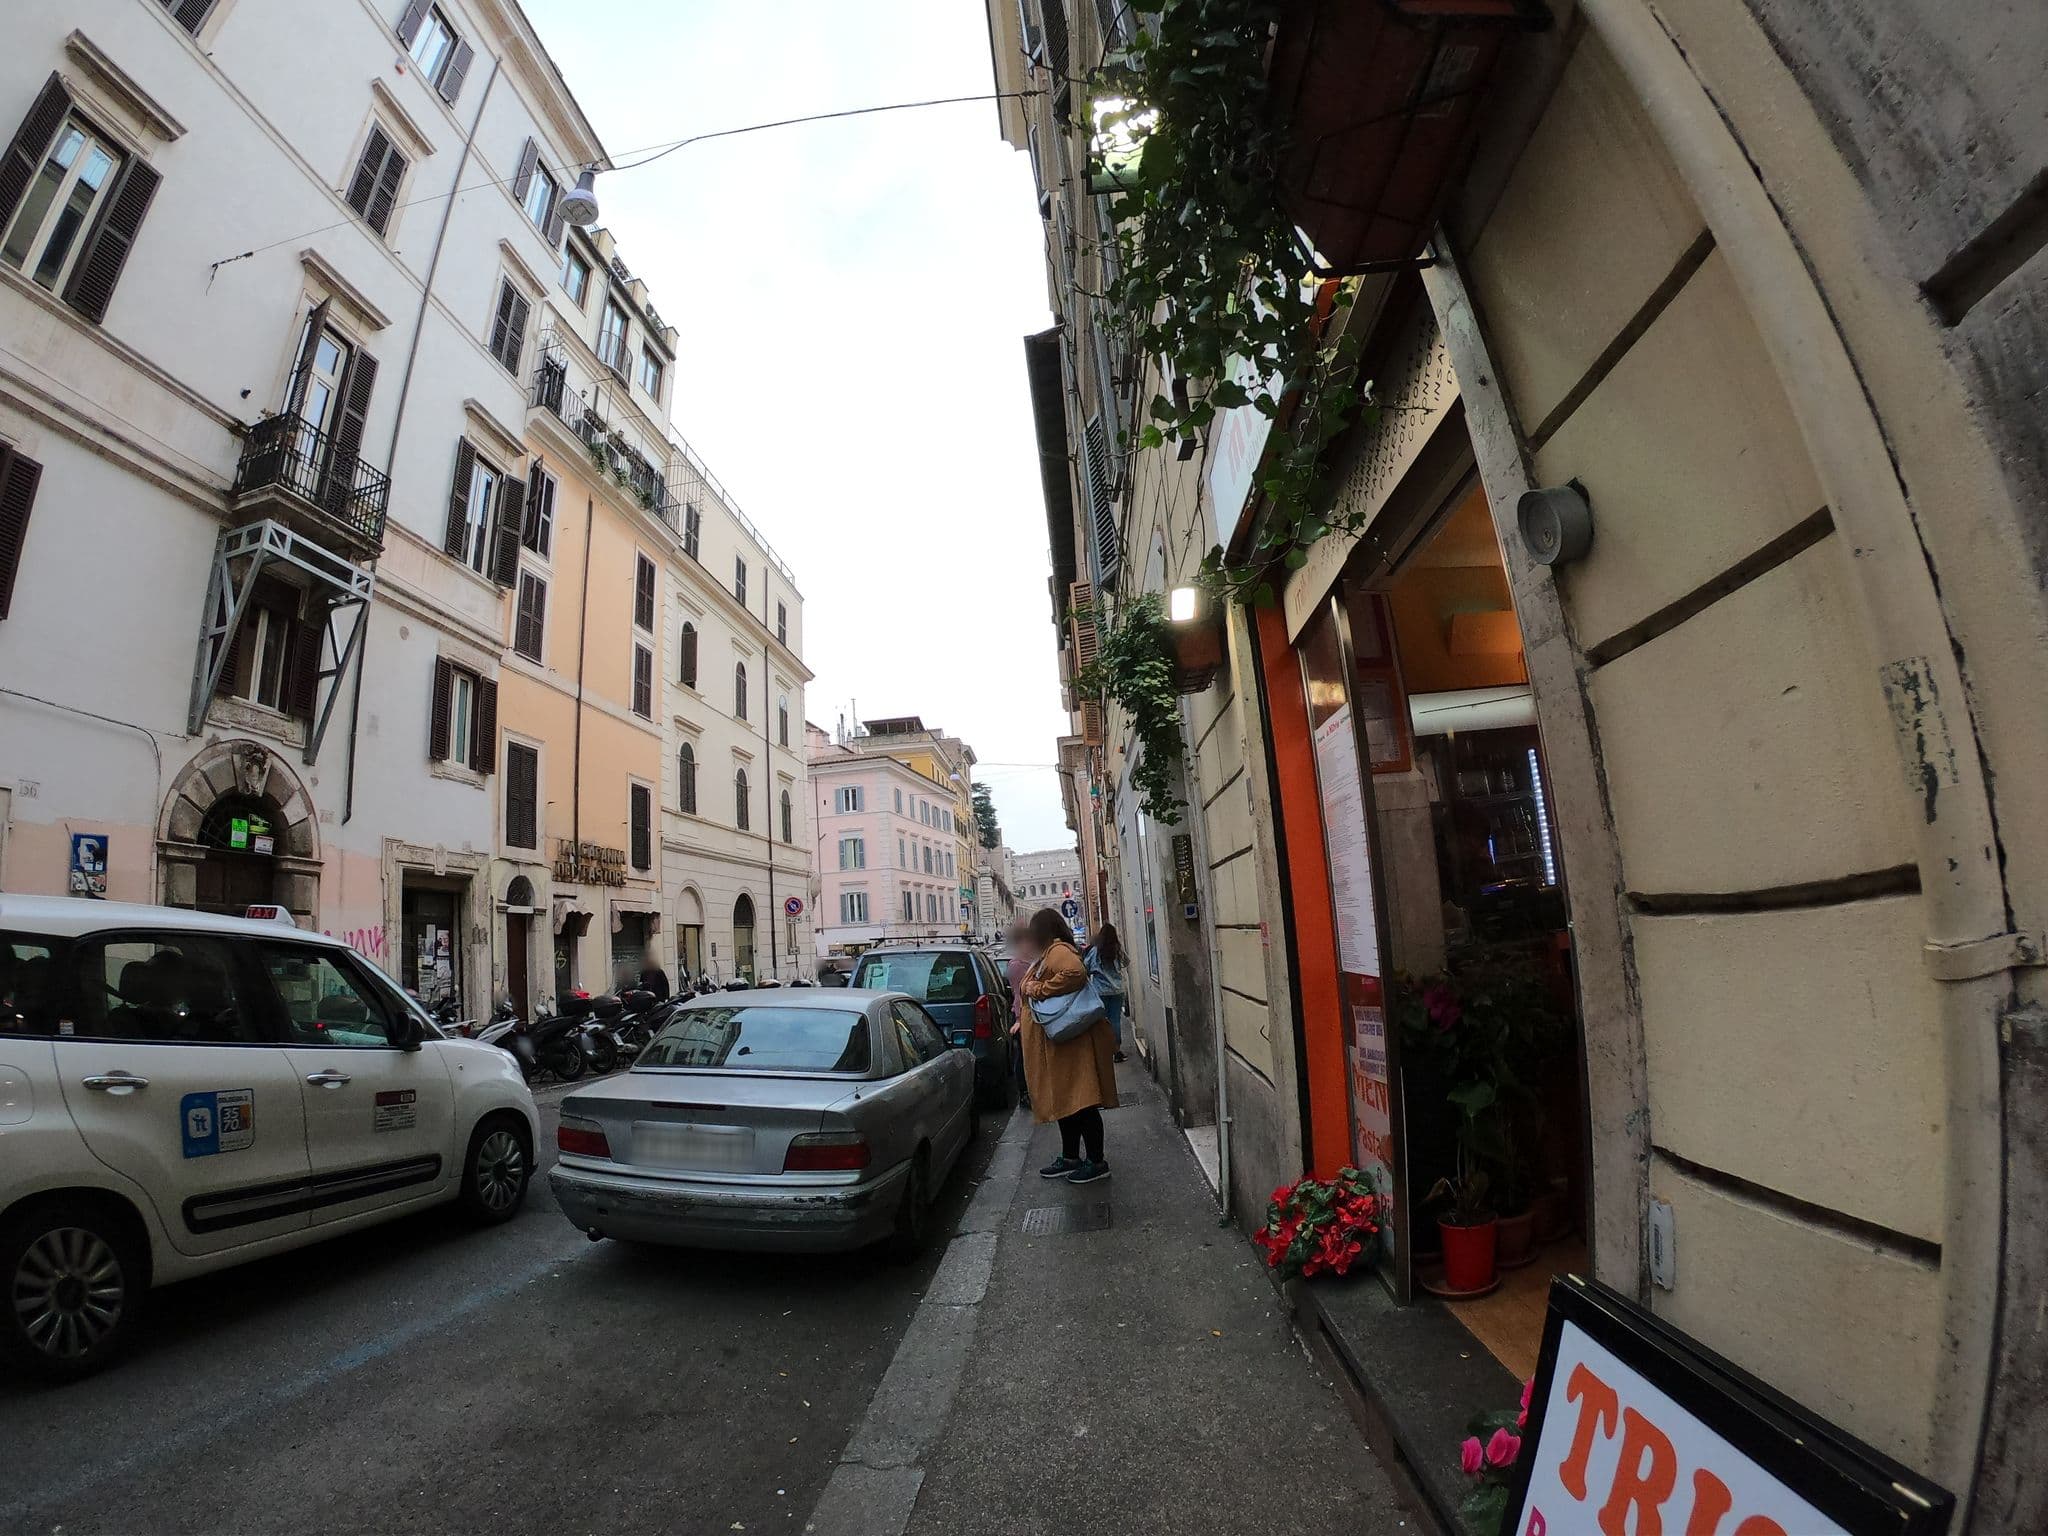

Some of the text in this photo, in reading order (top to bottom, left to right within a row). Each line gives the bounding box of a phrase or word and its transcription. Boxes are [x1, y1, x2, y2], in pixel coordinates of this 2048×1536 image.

[248, 907, 275, 919] TAXI
[222, 1106, 239, 1120] 35
[222, 1118, 239, 1131] 70
[1559, 1362, 1788, 1536] TRI
